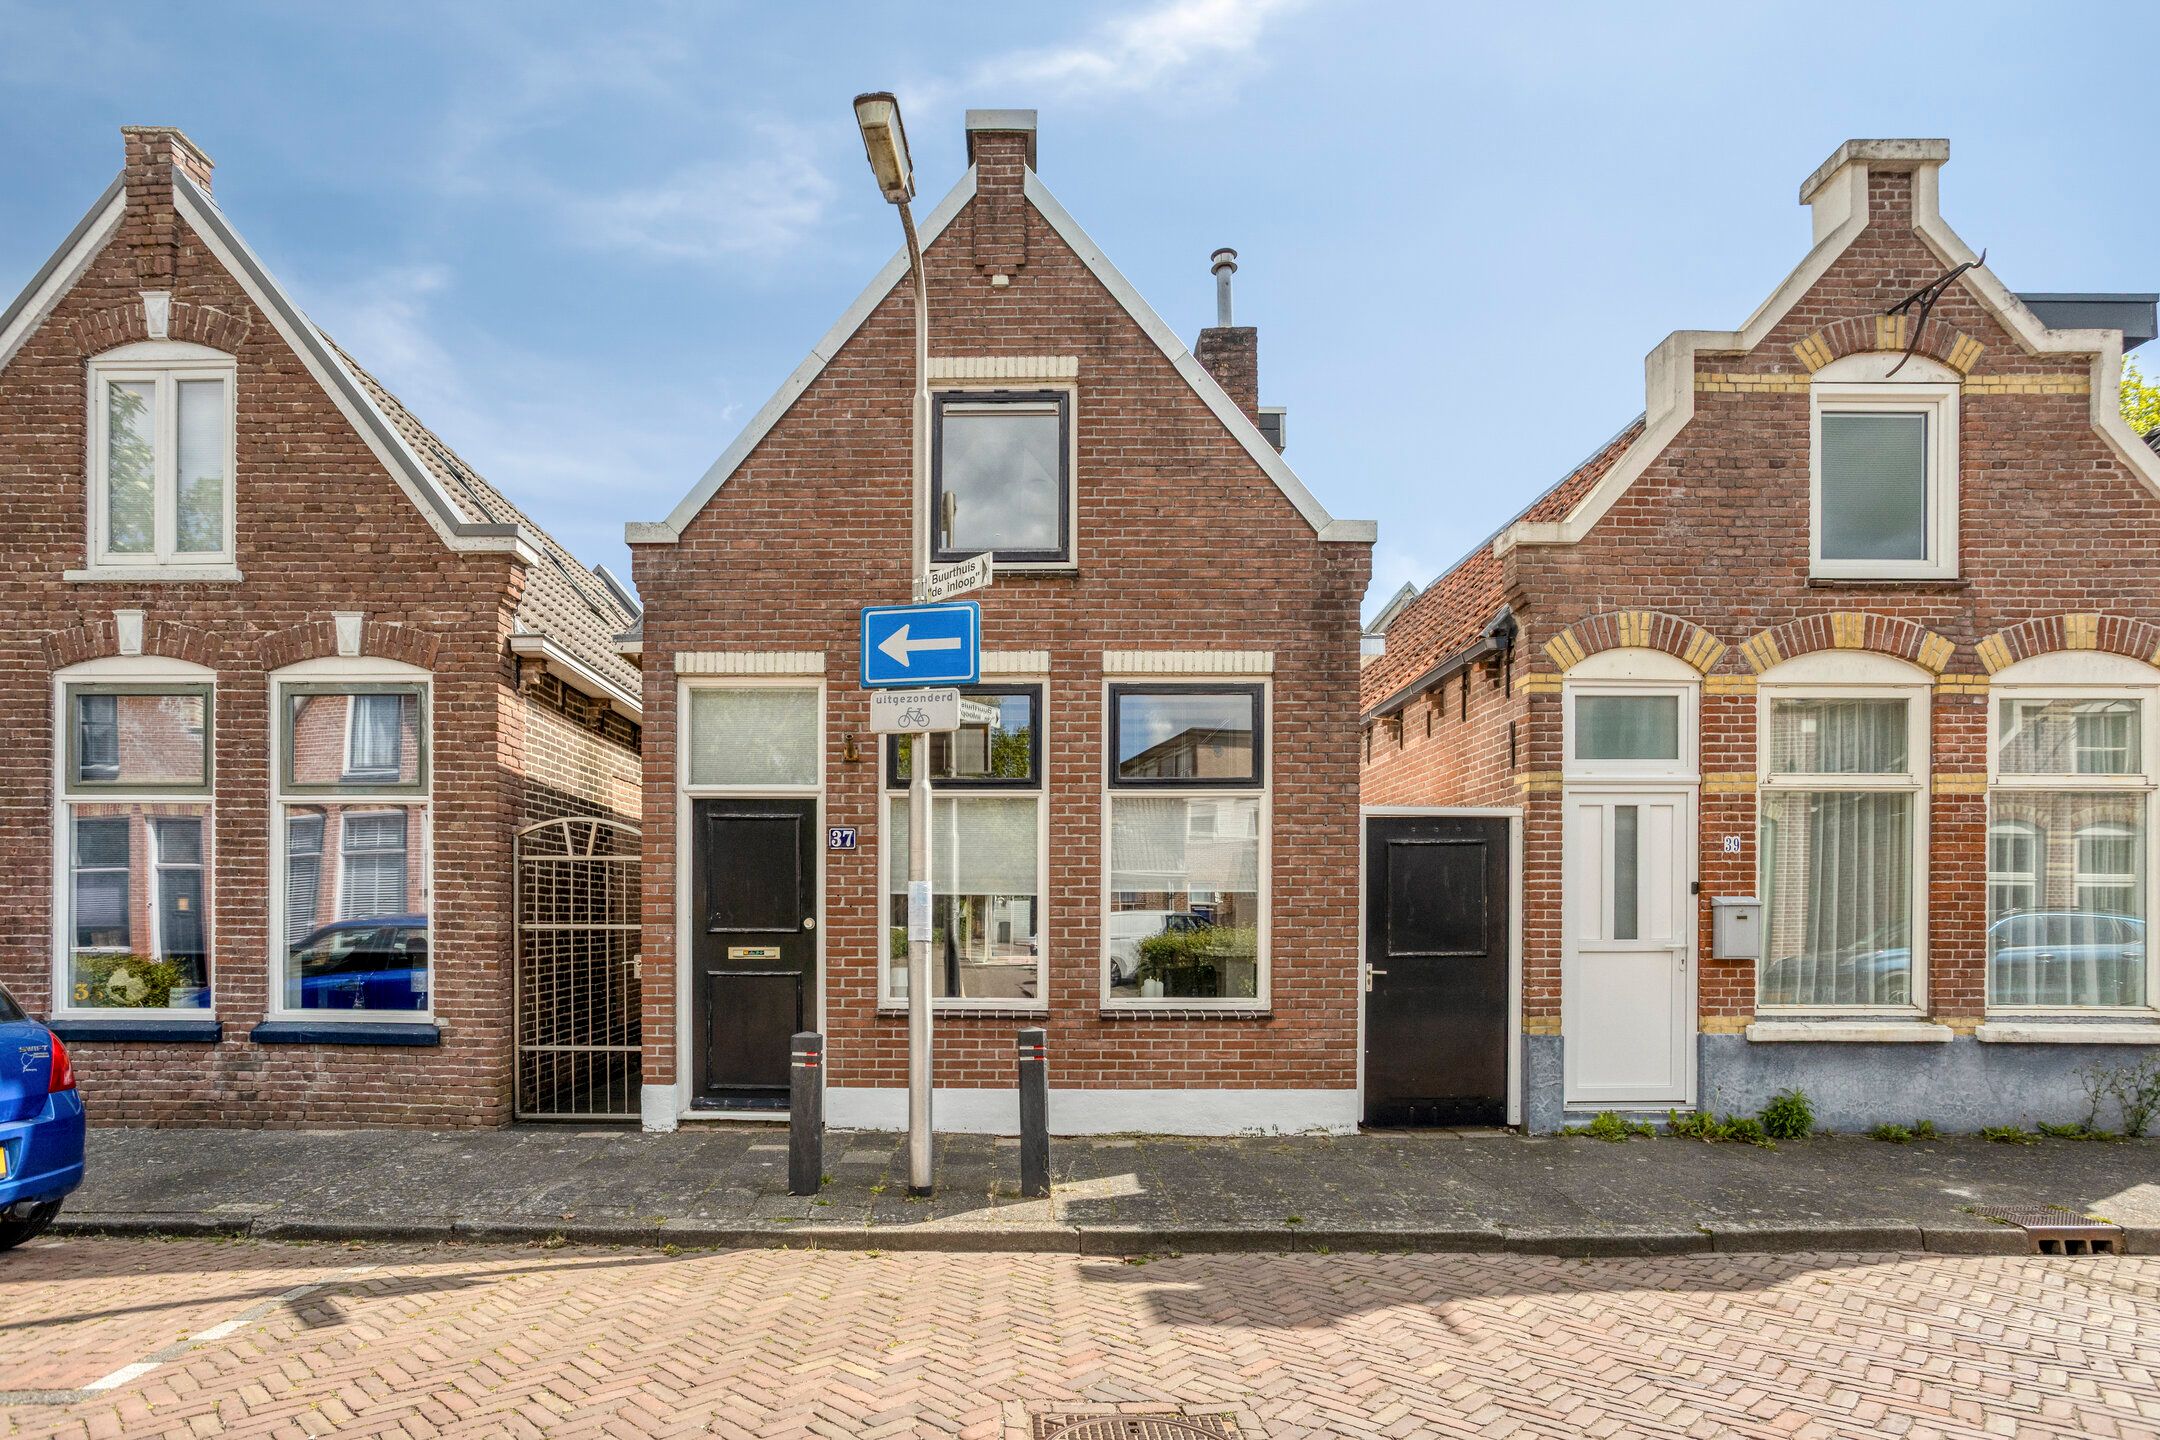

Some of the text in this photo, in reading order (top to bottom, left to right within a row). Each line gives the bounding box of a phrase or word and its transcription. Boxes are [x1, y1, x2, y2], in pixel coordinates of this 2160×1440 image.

[932, 562, 976, 585] Buurthuis
[927, 571, 980, 598] "de inloop"
[876, 693, 953, 706] uitgezonderd
[831, 830, 854, 847] 37
[1725, 837, 1740, 851] 39
[18, 1045, 48, 1053] SWIFT
